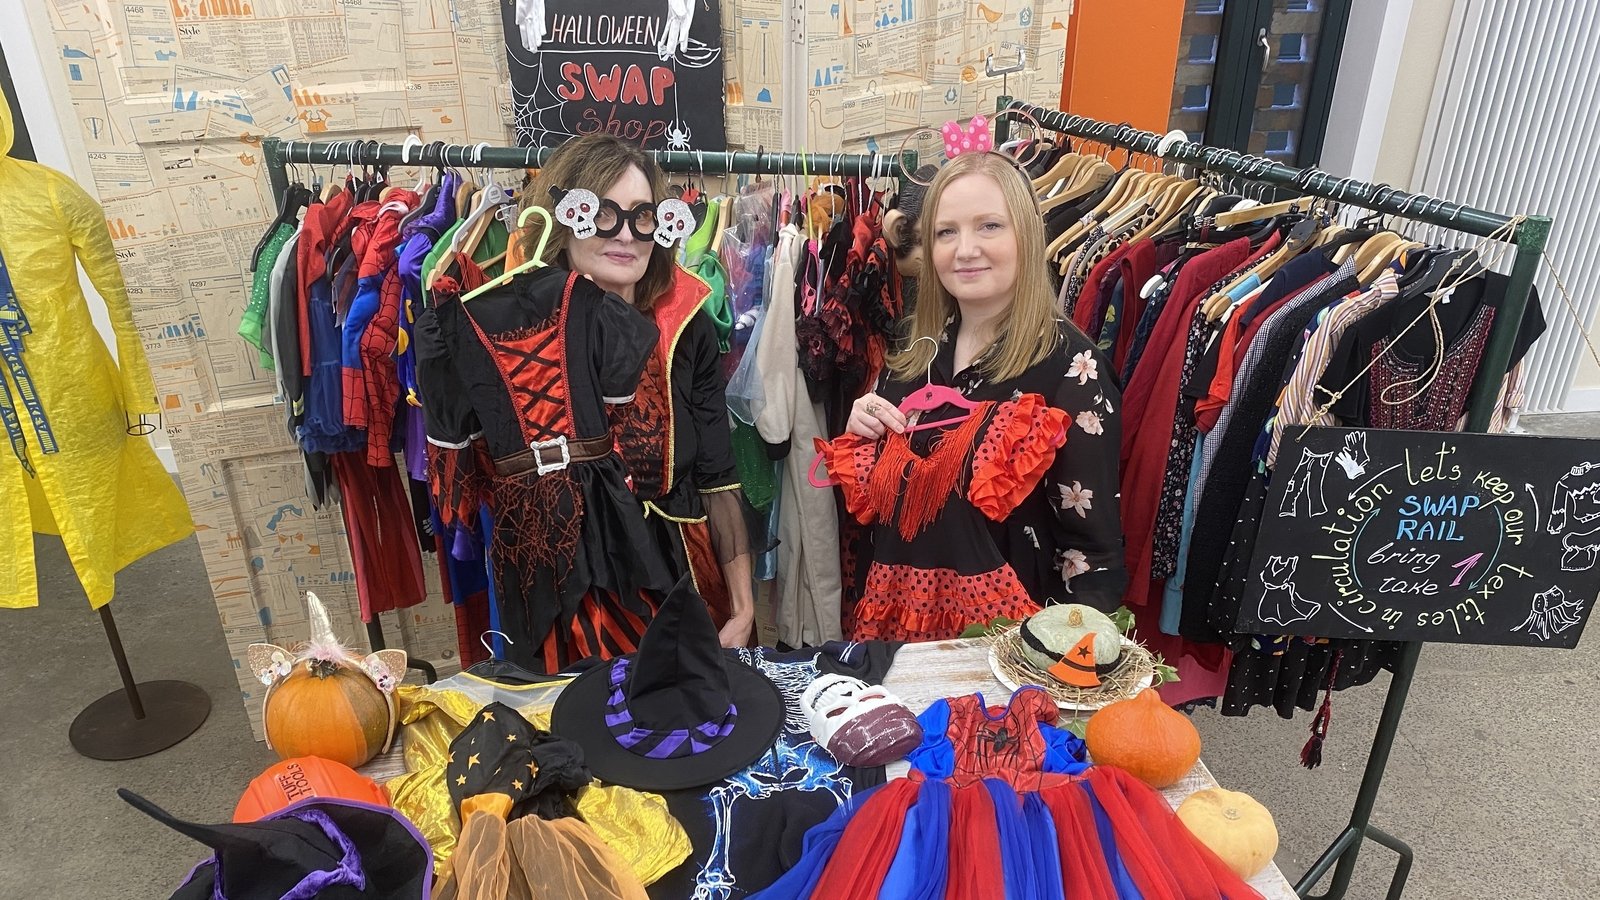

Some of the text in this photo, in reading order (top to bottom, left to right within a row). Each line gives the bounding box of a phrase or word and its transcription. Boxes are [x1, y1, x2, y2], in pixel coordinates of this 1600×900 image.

[125, 6, 144, 14] 4468
[178, 26, 200, 37] Style
[551, 13, 660, 47] HALLOWEEN
[557, 61, 675, 106] SWAP
[575, 104, 667, 150] Shop
[115, 249, 136, 260] Style
[190, 280, 207, 288] 4297
[145, 342, 161, 350] 3773
[1404, 441, 1462, 486] let's
[1398, 494, 1480, 518] SWAP
[1472, 470, 1515, 511] keep
[1396, 519, 1464, 541] RAIL
[1503, 508, 1524, 546] our
[1311, 483, 1393, 614] circulation
[1367, 542, 1441, 574] bring
[1449, 552, 1484, 587] 1
[1378, 576, 1439, 596] take
[278, 775, 300, 801] TUFF
[286, 763, 312, 796] TOOLS
